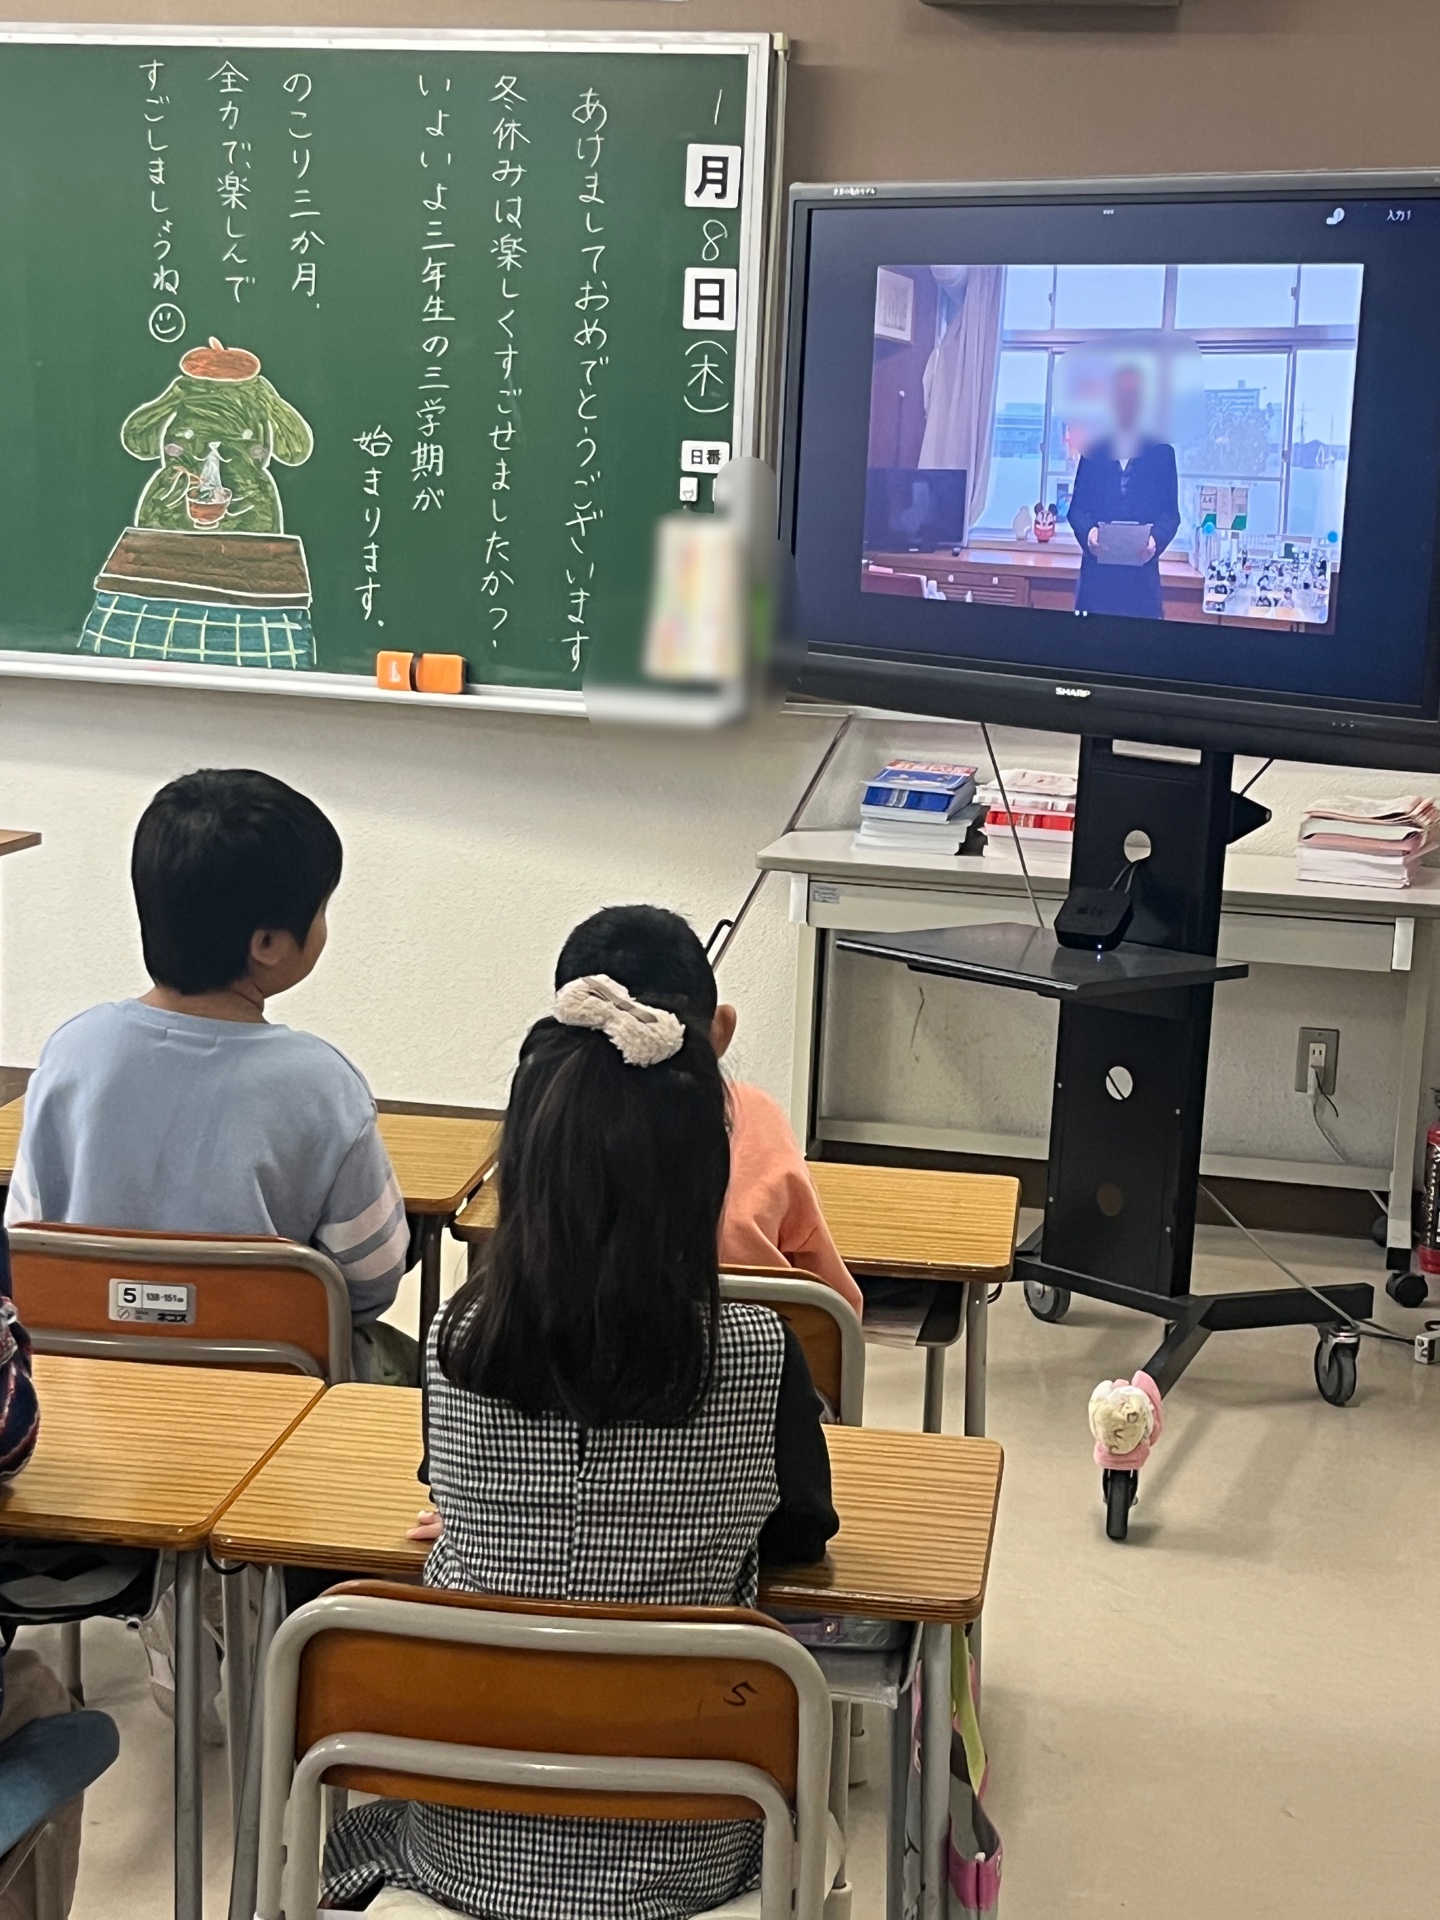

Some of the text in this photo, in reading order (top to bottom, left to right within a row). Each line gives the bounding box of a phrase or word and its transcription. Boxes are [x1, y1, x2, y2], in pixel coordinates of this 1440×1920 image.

[139, 59, 180, 296] すごしましょうね
[410, 75, 456, 512] いよいよ三年生の三学期が
[561, 87, 609, 673] あけましておめでとうございます
[1055, 686, 1091, 698] SHARP
[123, 1287, 137, 1304] 5
[722, 1681, 759, 1707] 5
